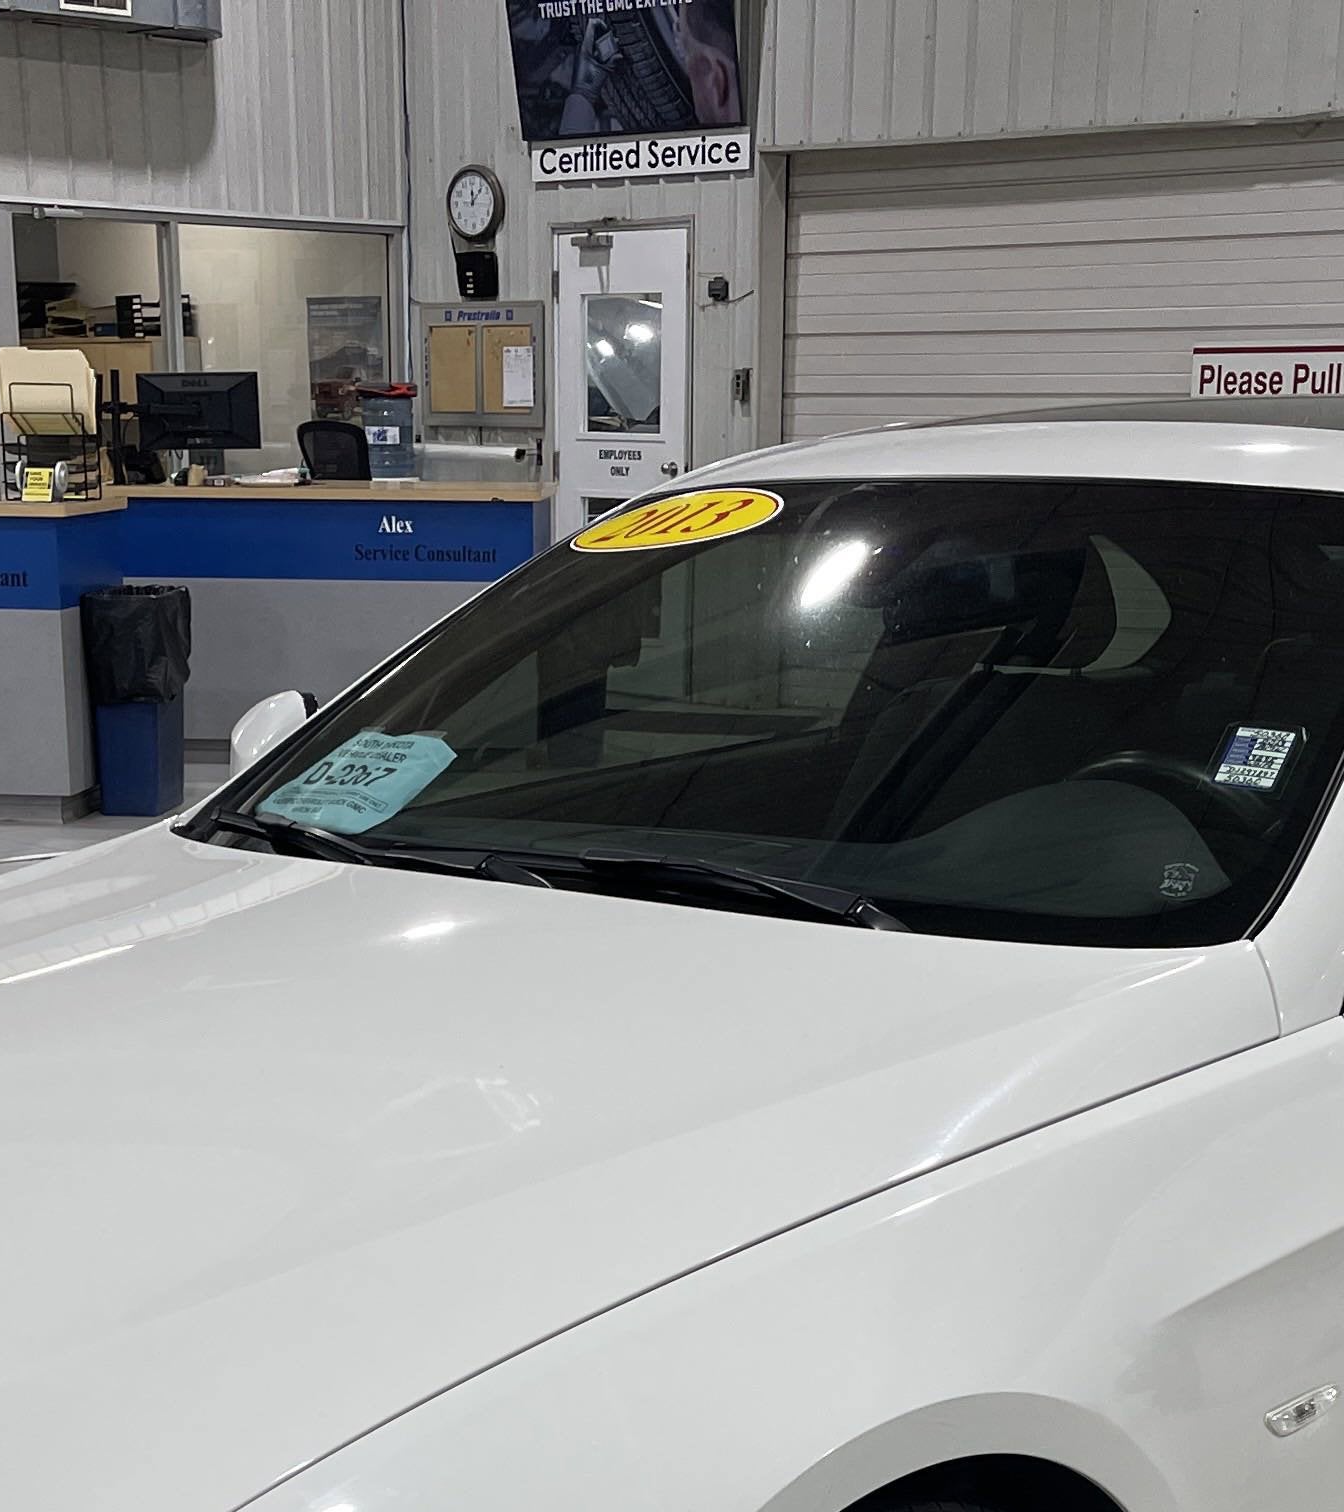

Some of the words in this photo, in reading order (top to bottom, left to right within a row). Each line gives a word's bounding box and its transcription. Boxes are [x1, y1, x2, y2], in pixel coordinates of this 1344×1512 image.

[538, 0, 577, 18] TRUST
[579, 0, 604, 14] THE
[607, 0, 633, 11] GMC
[539, 141, 640, 175] Certified
[647, 136, 741, 168] Service
[1199, 364, 1283, 395] Please
[1293, 362, 1342, 394] Pull
[598, 449, 642, 462] EMPLOYEES
[610, 465, 630, 478] ONLY
[378, 515, 413, 534] Alex
[589, 497, 755, 543] 2013
[355, 543, 409, 562] Service
[414, 545, 497, 564] Consultant
